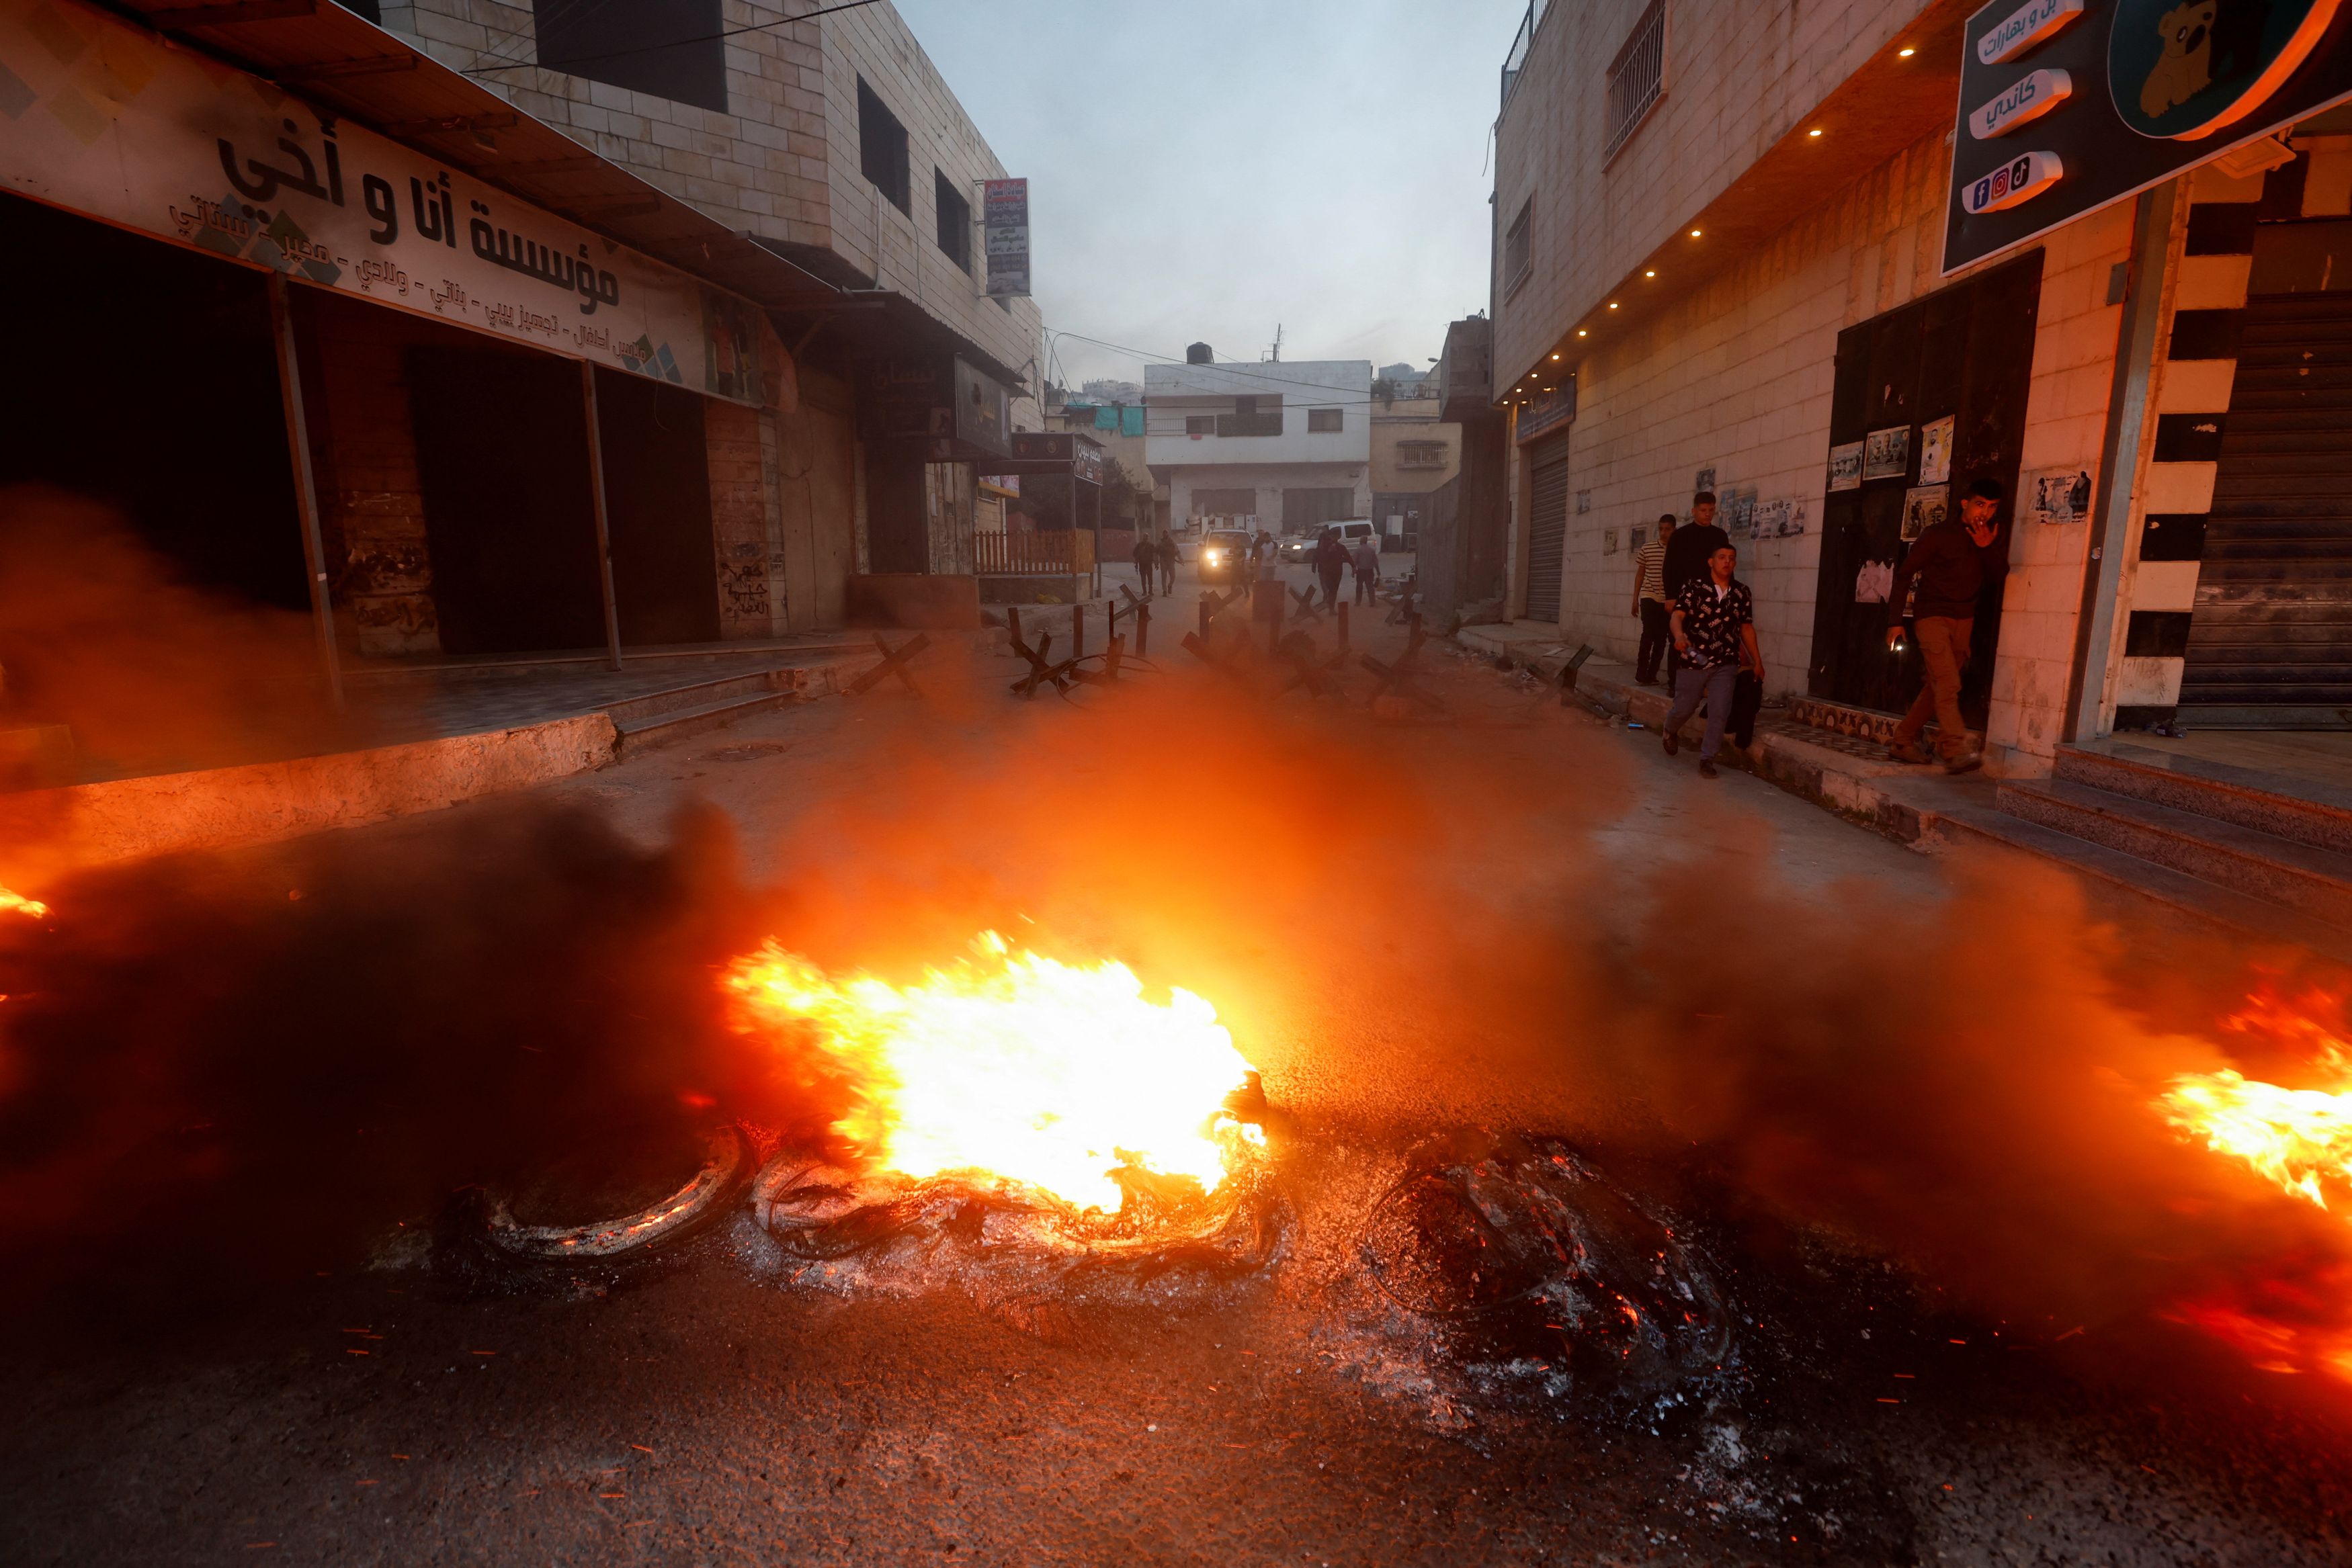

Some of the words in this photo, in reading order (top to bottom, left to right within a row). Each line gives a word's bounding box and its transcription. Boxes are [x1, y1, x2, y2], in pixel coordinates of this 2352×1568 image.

[1984, 17, 2027, 56] بهارات
[2029, 9, 2038, 28] و
[1986, 75, 2035, 130] كاندي
[217, 118, 345, 224] أخي
[169, 195, 249, 238] ستاتي
[363, 173, 398, 245] و
[410, 171, 456, 249] أنا
[355, 259, 409, 296] ولادي
[470, 200, 618, 314] مؤسسة
[430, 279, 466, 312] بناتي
[517, 304, 558, 338] تجهيز
[613, 341, 646, 361] ملابس
